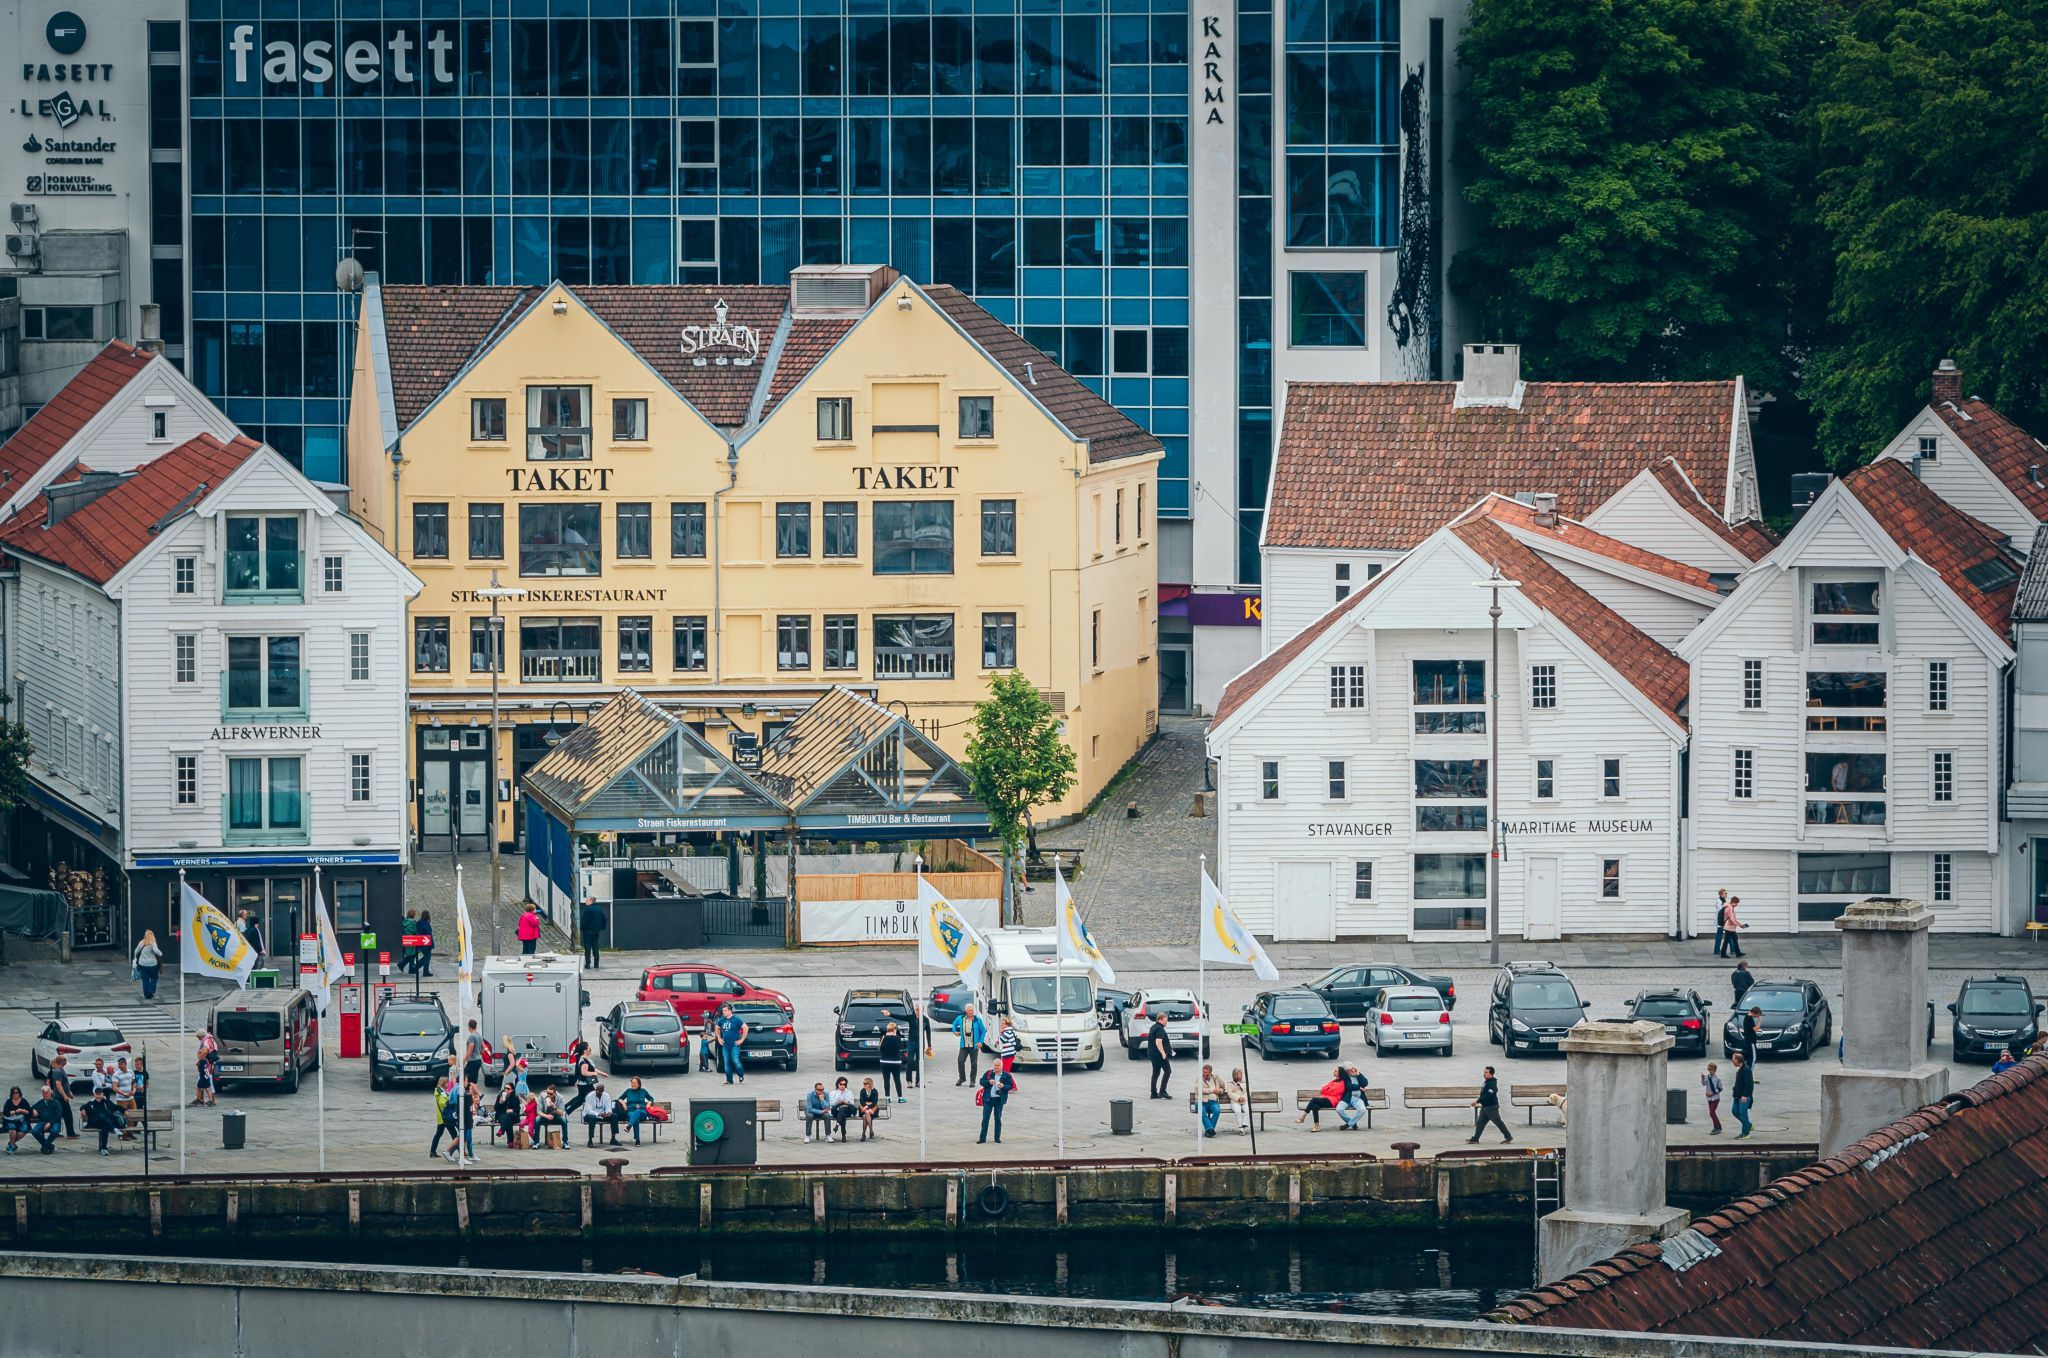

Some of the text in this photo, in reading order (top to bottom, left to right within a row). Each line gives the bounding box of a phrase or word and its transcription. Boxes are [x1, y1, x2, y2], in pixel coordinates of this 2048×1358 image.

[229, 25, 454, 83] fasett
[23, 64, 113, 81] FASETT
[1201, 16, 1224, 125] KARMA
[21, 99, 111, 117] LEGAL
[44, 137, 117, 153] Santander
[47, 176, 95, 184] FORMUES-
[47, 184, 113, 192] FORVALTNING
[505, 468, 614, 491] TAKET
[852, 466, 959, 489] TAKET
[451, 590, 513, 602] STRAN
[518, 589, 667, 602] FISKERESTAURANT
[1243, 597, 1262, 620] K
[210, 726, 322, 740] ALF&WERNER
[638, 817, 727, 828] Straen Fiskerestaurant
[847, 813, 951, 824] TIMBUKTU Bar & Restaurant
[1308, 823, 1392, 836] STAVANGER
[1504, 820, 1653, 834] MARITIME MUSEUM
[172, 858, 210, 866] WERNERS
[306, 856, 344, 864] WERNERS
[865, 915, 918, 935] TIMBUK
